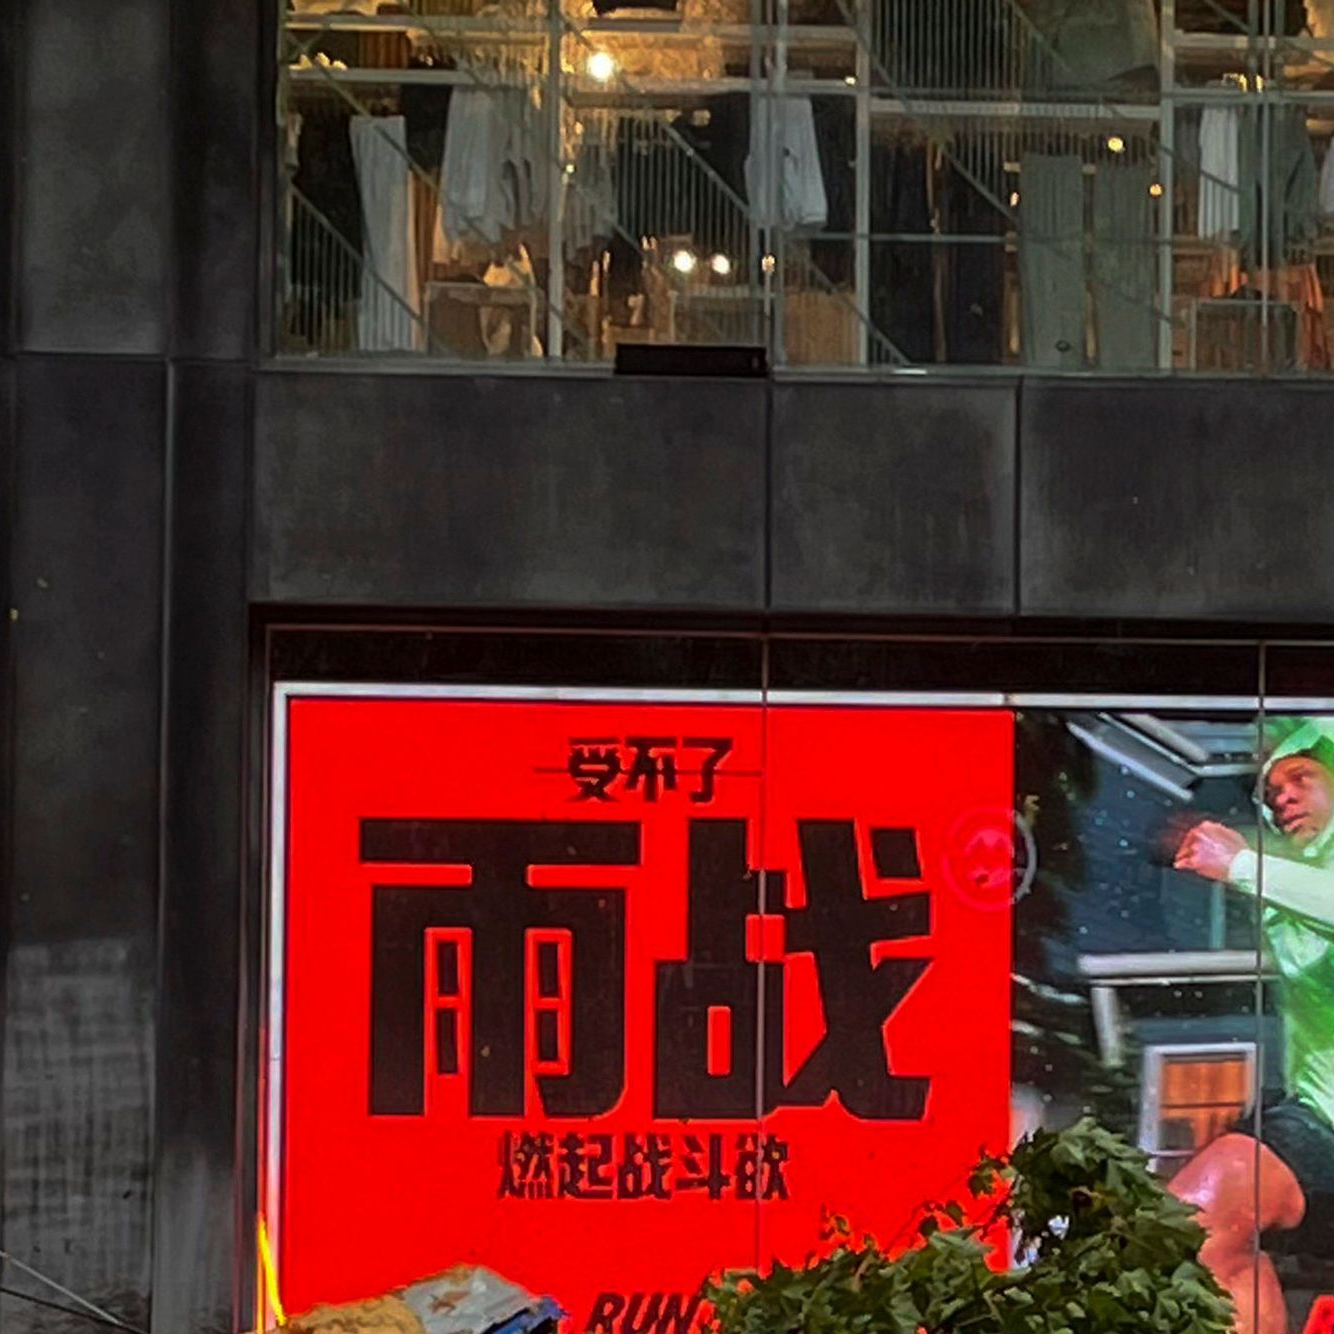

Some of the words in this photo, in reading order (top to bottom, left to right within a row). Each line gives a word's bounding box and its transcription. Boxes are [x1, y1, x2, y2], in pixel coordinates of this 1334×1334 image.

[359, 818, 934, 1122] 雨战
[496, 1131, 791, 1200] 燃起战斗欲
